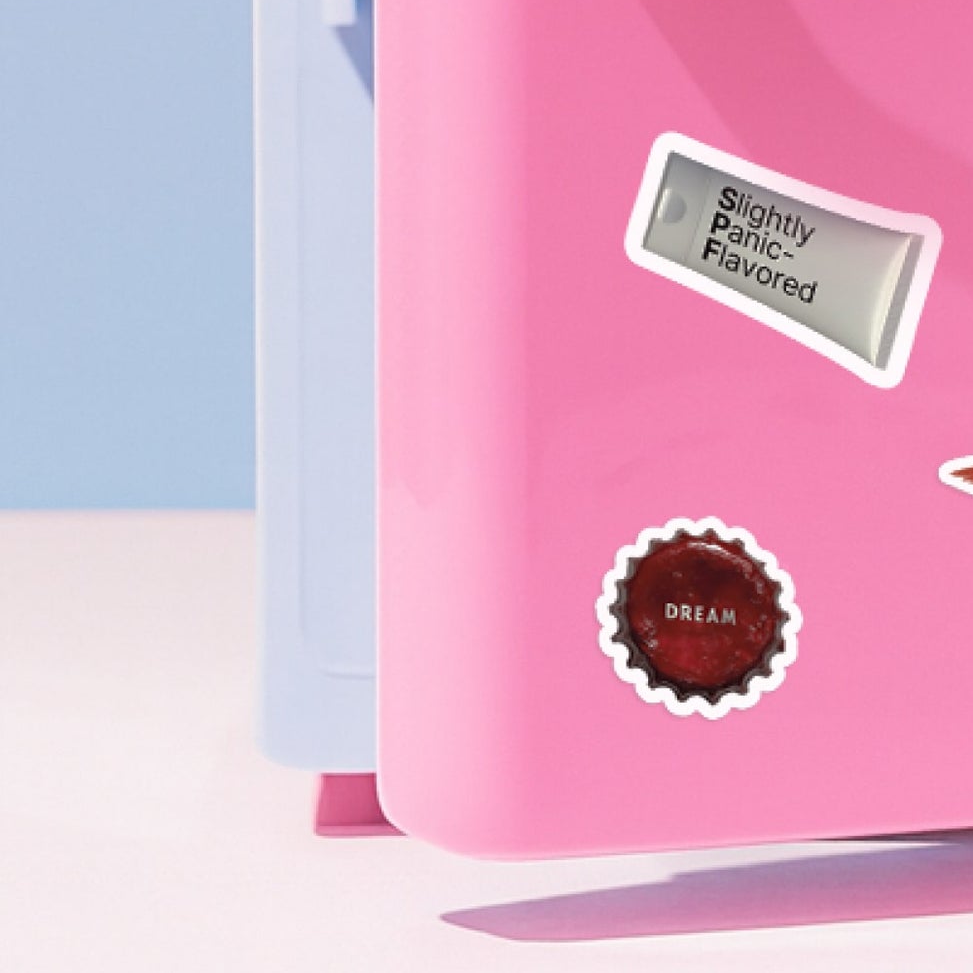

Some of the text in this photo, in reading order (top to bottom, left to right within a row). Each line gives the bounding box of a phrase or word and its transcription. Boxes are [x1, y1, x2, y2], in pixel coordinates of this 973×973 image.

[710, 212, 795, 260] Panic-
[718, 186, 816, 247] Slightly
[701, 237, 819, 304] Flavored
[664, 602, 737, 626] DREAM
